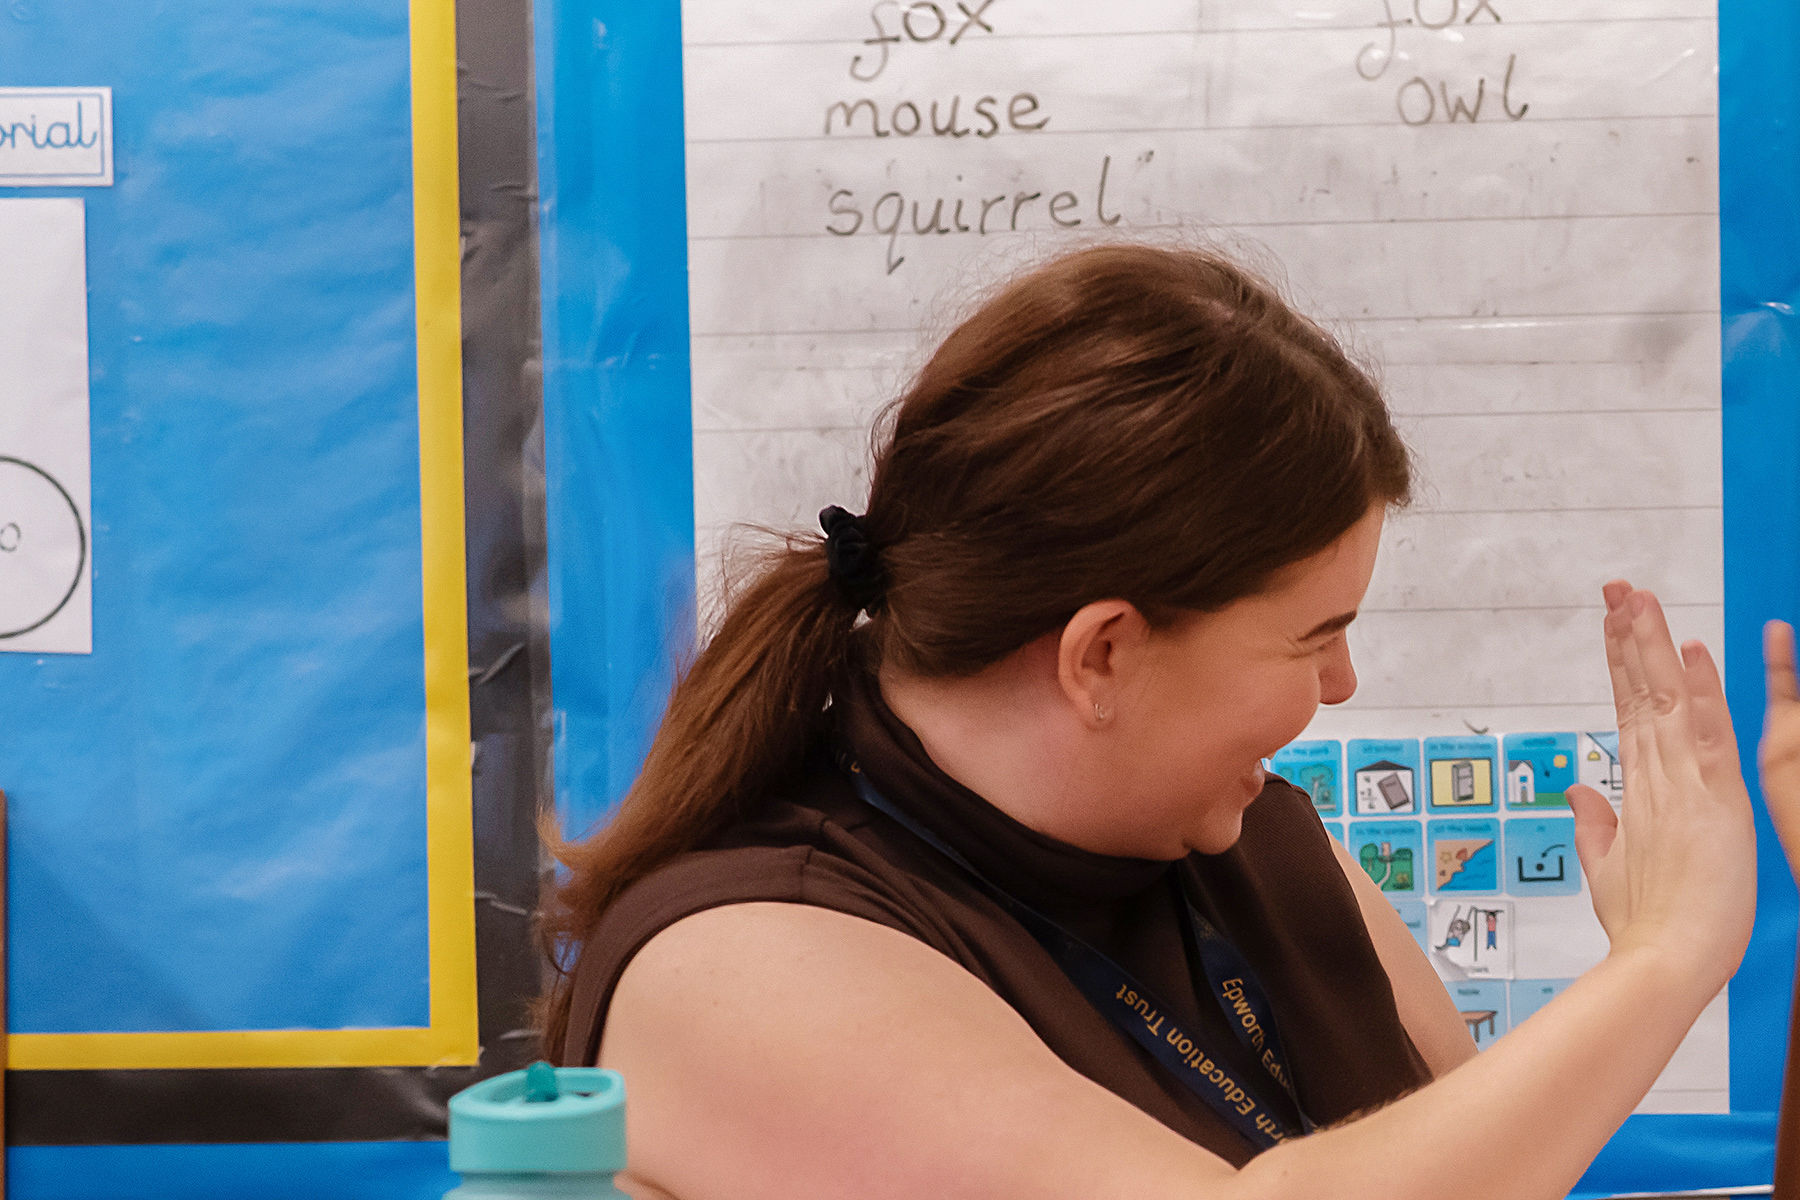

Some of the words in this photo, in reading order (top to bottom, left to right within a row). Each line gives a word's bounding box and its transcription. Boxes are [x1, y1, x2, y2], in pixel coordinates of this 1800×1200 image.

[850, 0, 996, 82] fox
[0, 101, 98, 149] rial
[823, 92, 1051, 139] mouse
[1397, 53, 1529, 126] owl
[826, 155, 1122, 276] squirrel
[1115, 983, 1165, 1037] Trust
[1222, 977, 1265, 1052] Epworth
[1261, 1048, 1290, 1090] Edu
[1166, 1027, 1256, 1115] Education
[1255, 1113, 1286, 1141] rth
